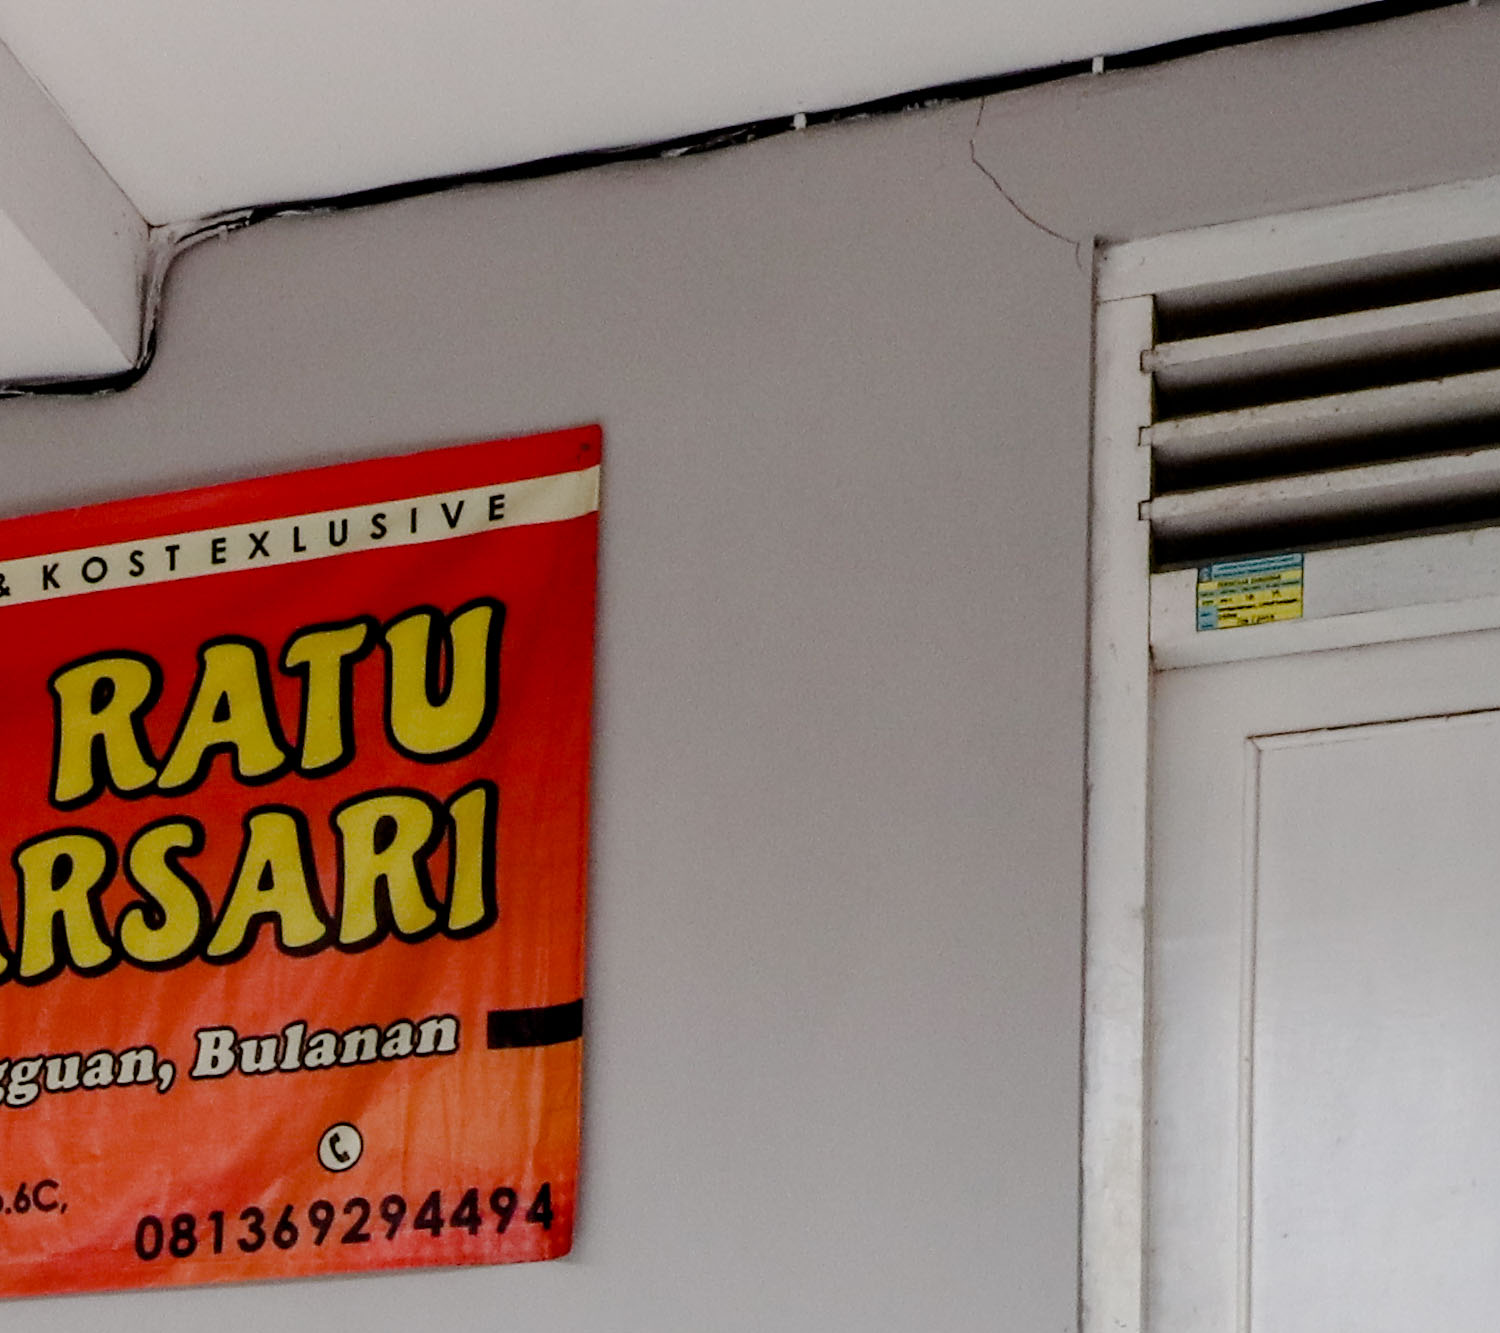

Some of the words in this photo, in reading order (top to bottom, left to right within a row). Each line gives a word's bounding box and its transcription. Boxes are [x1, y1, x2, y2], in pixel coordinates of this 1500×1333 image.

[42, 543, 181, 591] KOST
[211, 494, 506, 566] EXLUSIVE
[47, 597, 507, 811] RATU
[191, 1013, 461, 1081] Bulanan
[134, 1182, 554, 1261] 081369294494
